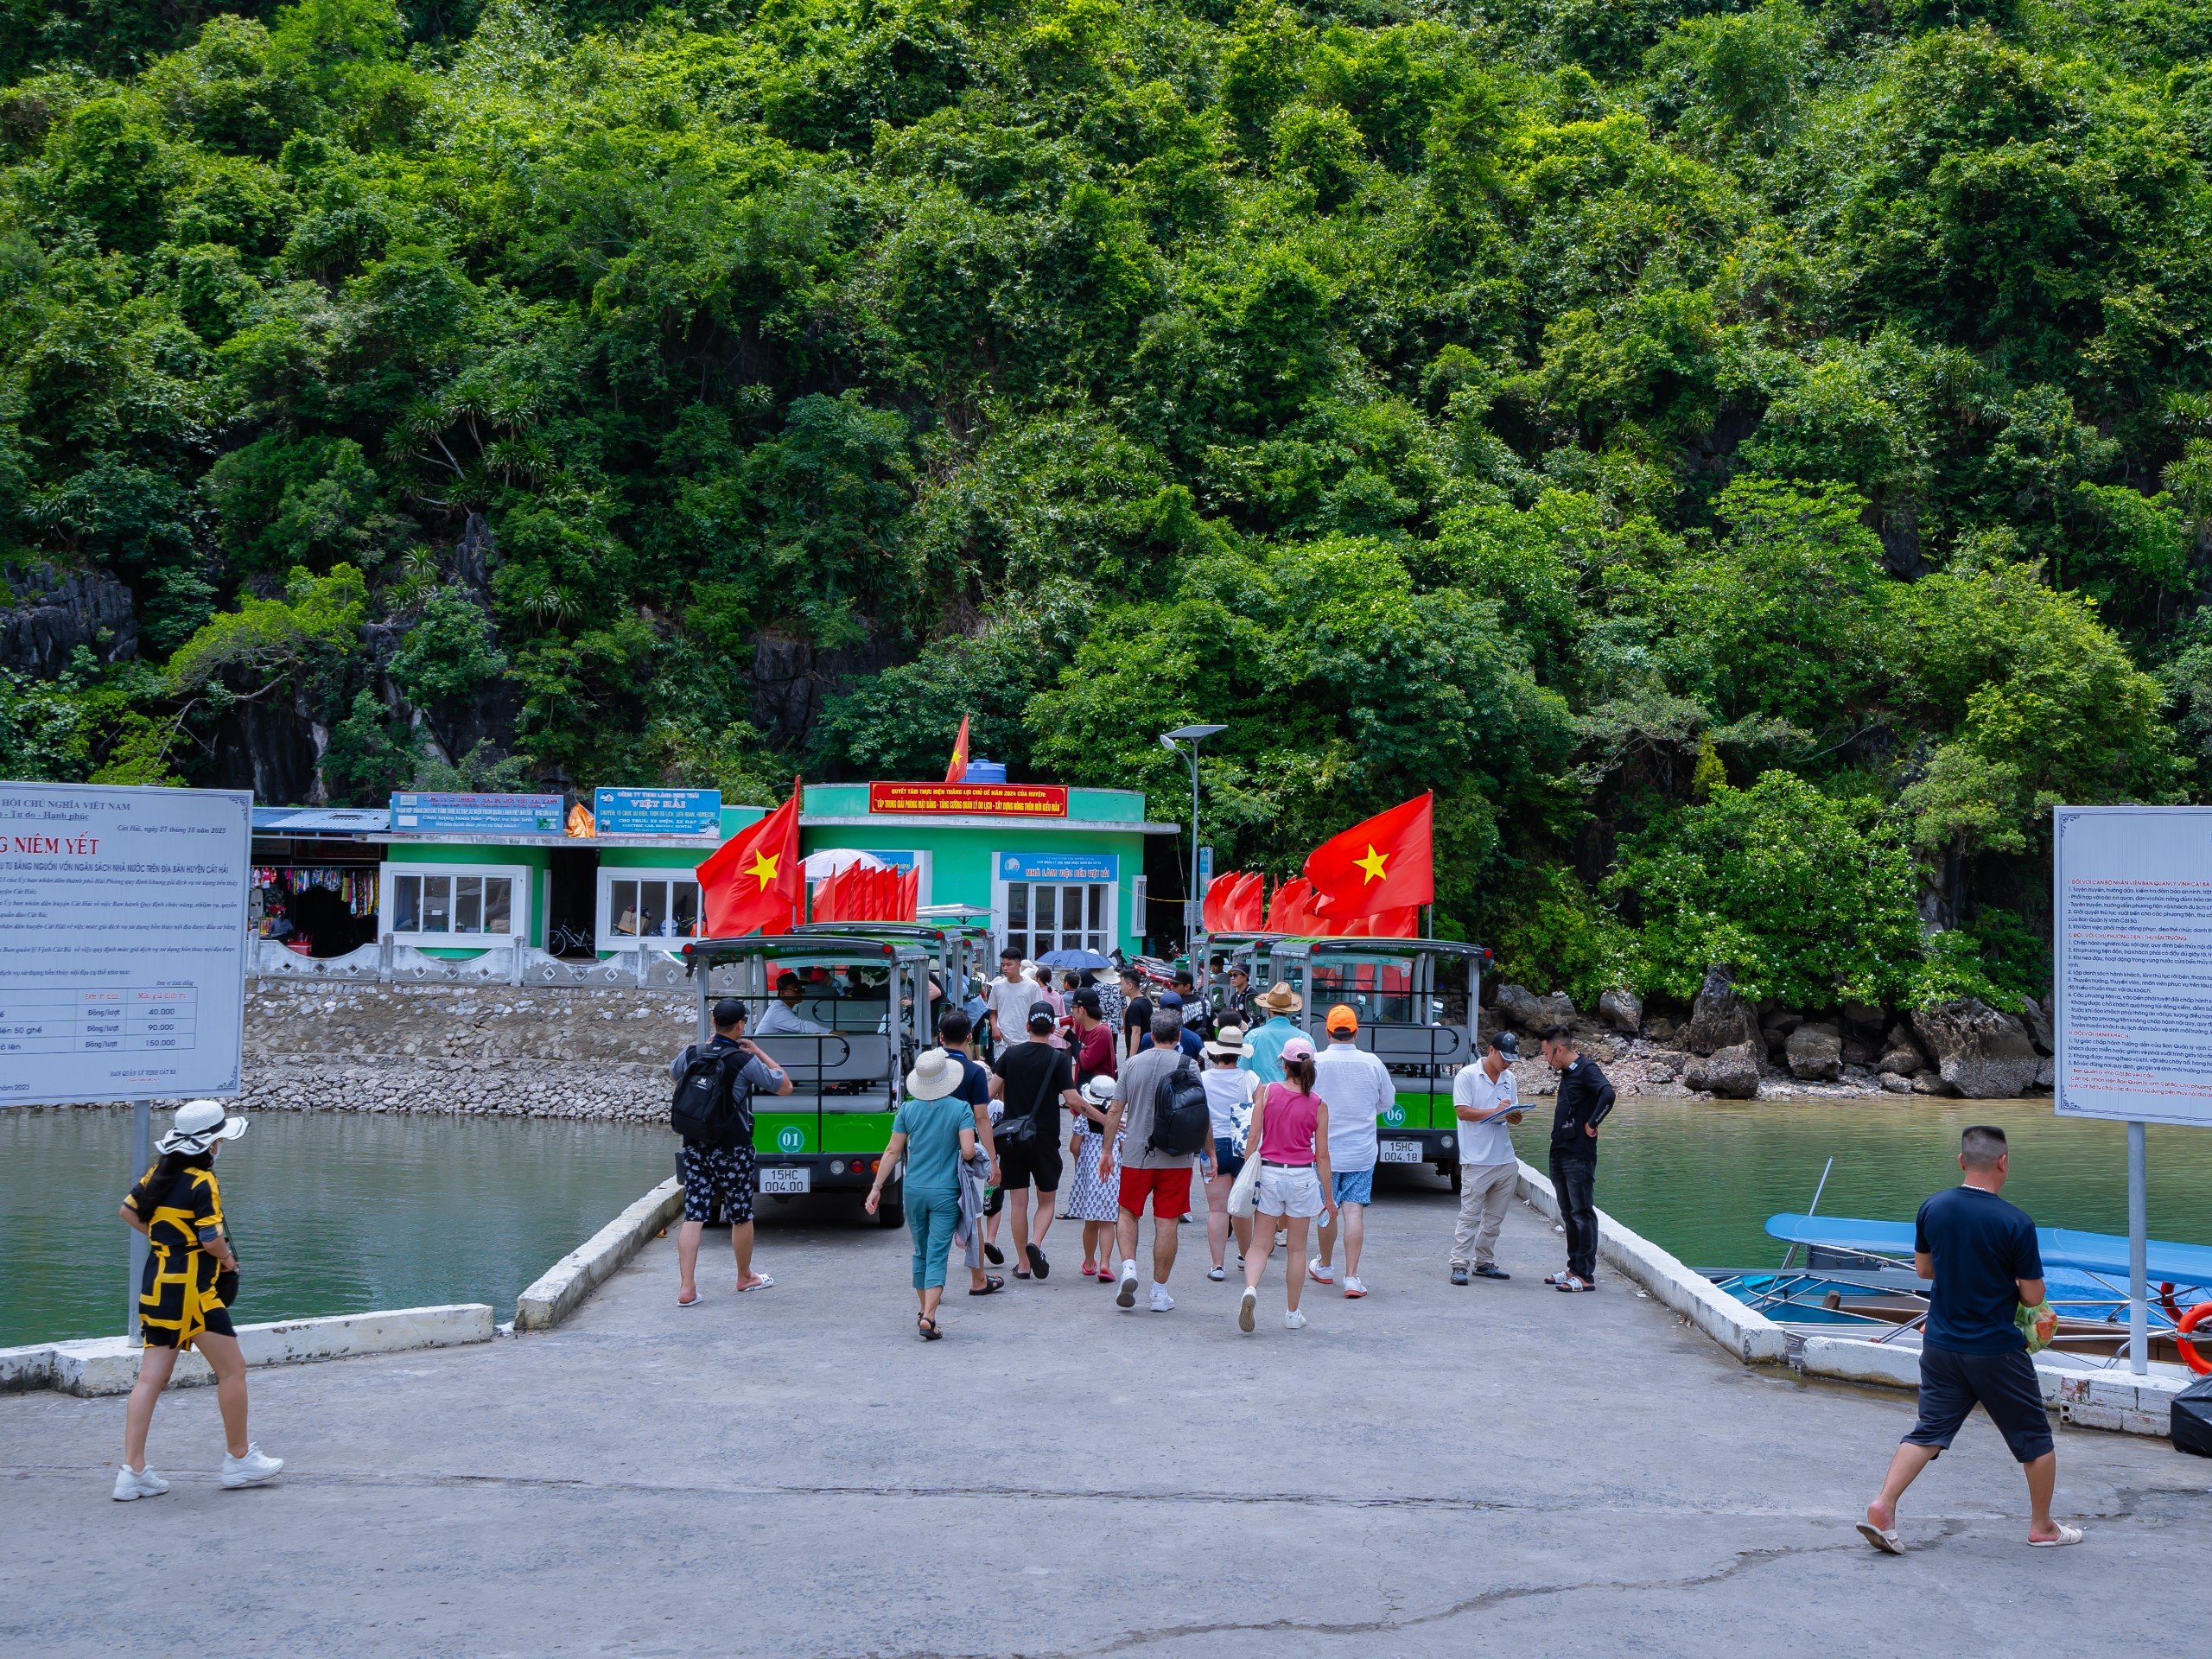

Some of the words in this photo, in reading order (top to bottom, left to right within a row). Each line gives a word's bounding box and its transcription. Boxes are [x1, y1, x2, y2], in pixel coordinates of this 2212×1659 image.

[2, 798, 21, 809] HỘI
[24, 798, 45, 808] CHỦ
[48, 799, 81, 810] NGHĨA
[83, 800, 106, 811] VIỆT
[108, 802, 130, 811] NAM
[631, 798, 660, 810] VIỆT
[663, 798, 687, 809] HẢI
[11, 810, 22, 818] Tự
[69, 812, 90, 821] phúc
[144, 825, 158, 834] ngày
[169, 825, 187, 834] tháng
[14, 832, 60, 854] NIÊM
[65, 830, 100, 855] YẾT
[1025, 867, 1040, 877] NHÀ
[1042, 868, 1058, 877] LÀM
[1058, 868, 1073, 879] VIỆC
[1074, 867, 1087, 878] BẾN
[1088, 868, 1100, 879] VIỆT
[1100, 867, 1109, 878] HẢI
[26, 1025, 43, 1035] ghế
[1387, 1109, 1402, 1121] 06
[782, 1132, 800, 1147] 01
[1390, 1141, 1414, 1152] 15HC
[1384, 1153, 1418, 1162] 004.18
[771, 1169, 798, 1180] 15HC
[765, 1180, 804, 1192] 004.00
